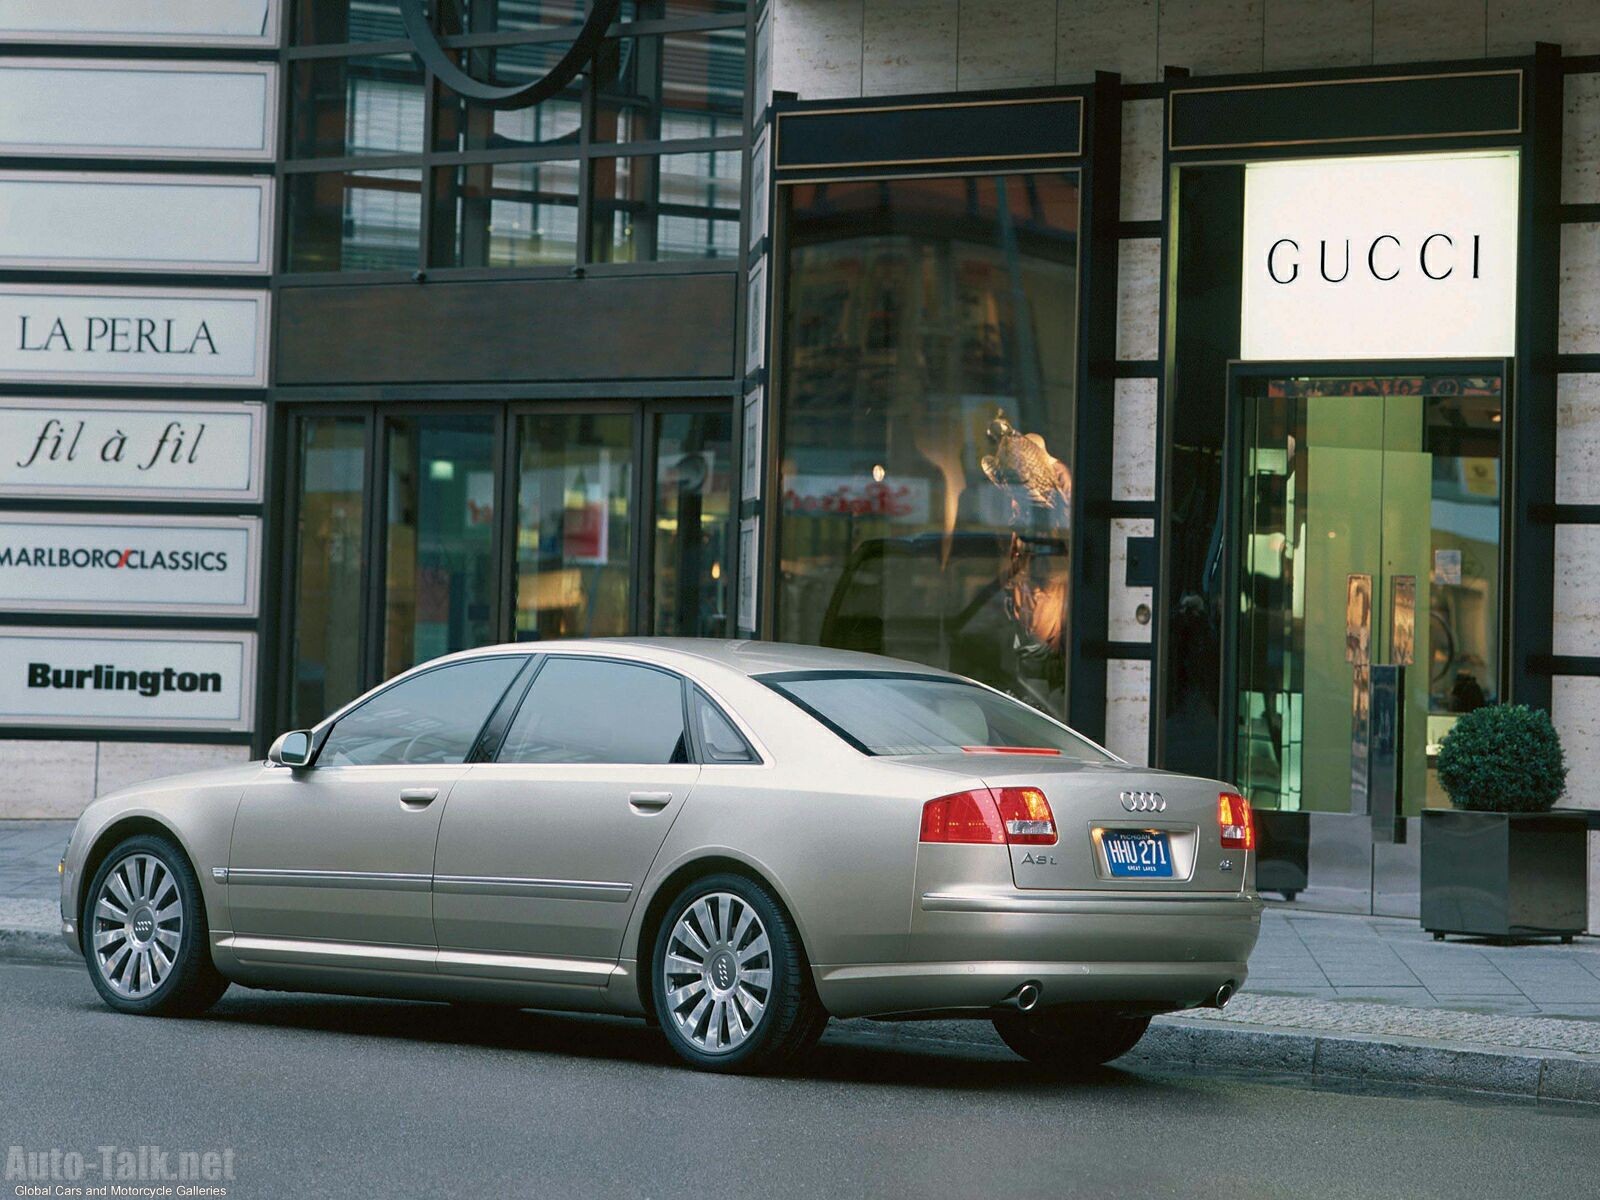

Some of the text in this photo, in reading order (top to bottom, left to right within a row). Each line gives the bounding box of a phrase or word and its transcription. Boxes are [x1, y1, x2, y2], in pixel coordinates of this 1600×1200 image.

[1267, 233, 1480, 284] GUCCI
[18, 315, 219, 355] LA PERLA
[16, 419, 205, 471] fil à fil
[28, 663, 222, 697] Burlington
[1108, 839, 1167, 865] HHU 271
